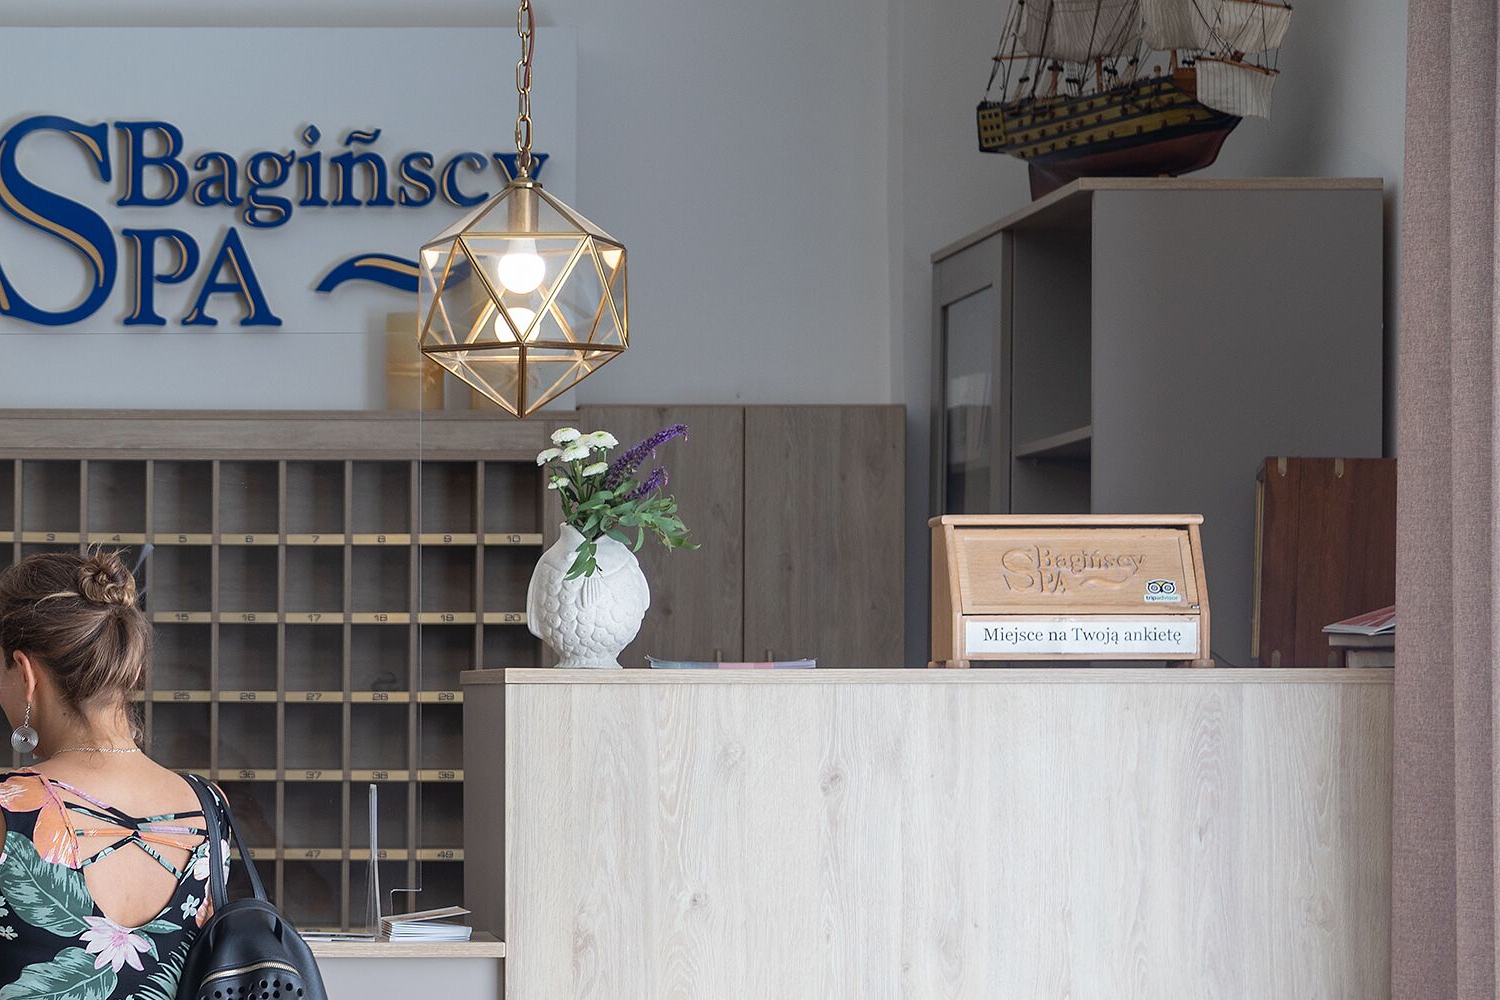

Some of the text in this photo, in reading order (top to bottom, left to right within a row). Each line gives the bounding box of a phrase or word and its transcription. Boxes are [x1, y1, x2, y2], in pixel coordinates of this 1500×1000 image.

[46, 533, 55, 541] 3
[112, 534, 121, 542] 4
[179, 535, 187, 543] 5
[312, 535, 320, 543] 7
[506, 535, 521, 543] 10
[1001, 548, 1067, 594] SPA
[175, 613, 189, 621] 15
[308, 614, 321, 622] 17
[374, 614, 388, 622] 18
[504, 614, 521, 622] 20
[983, 627, 1182, 645] Miejsce na Twoją ankietę
[306, 692, 322, 700] 27
[306, 771, 321, 779] 37
[305, 849, 321, 858] 47
